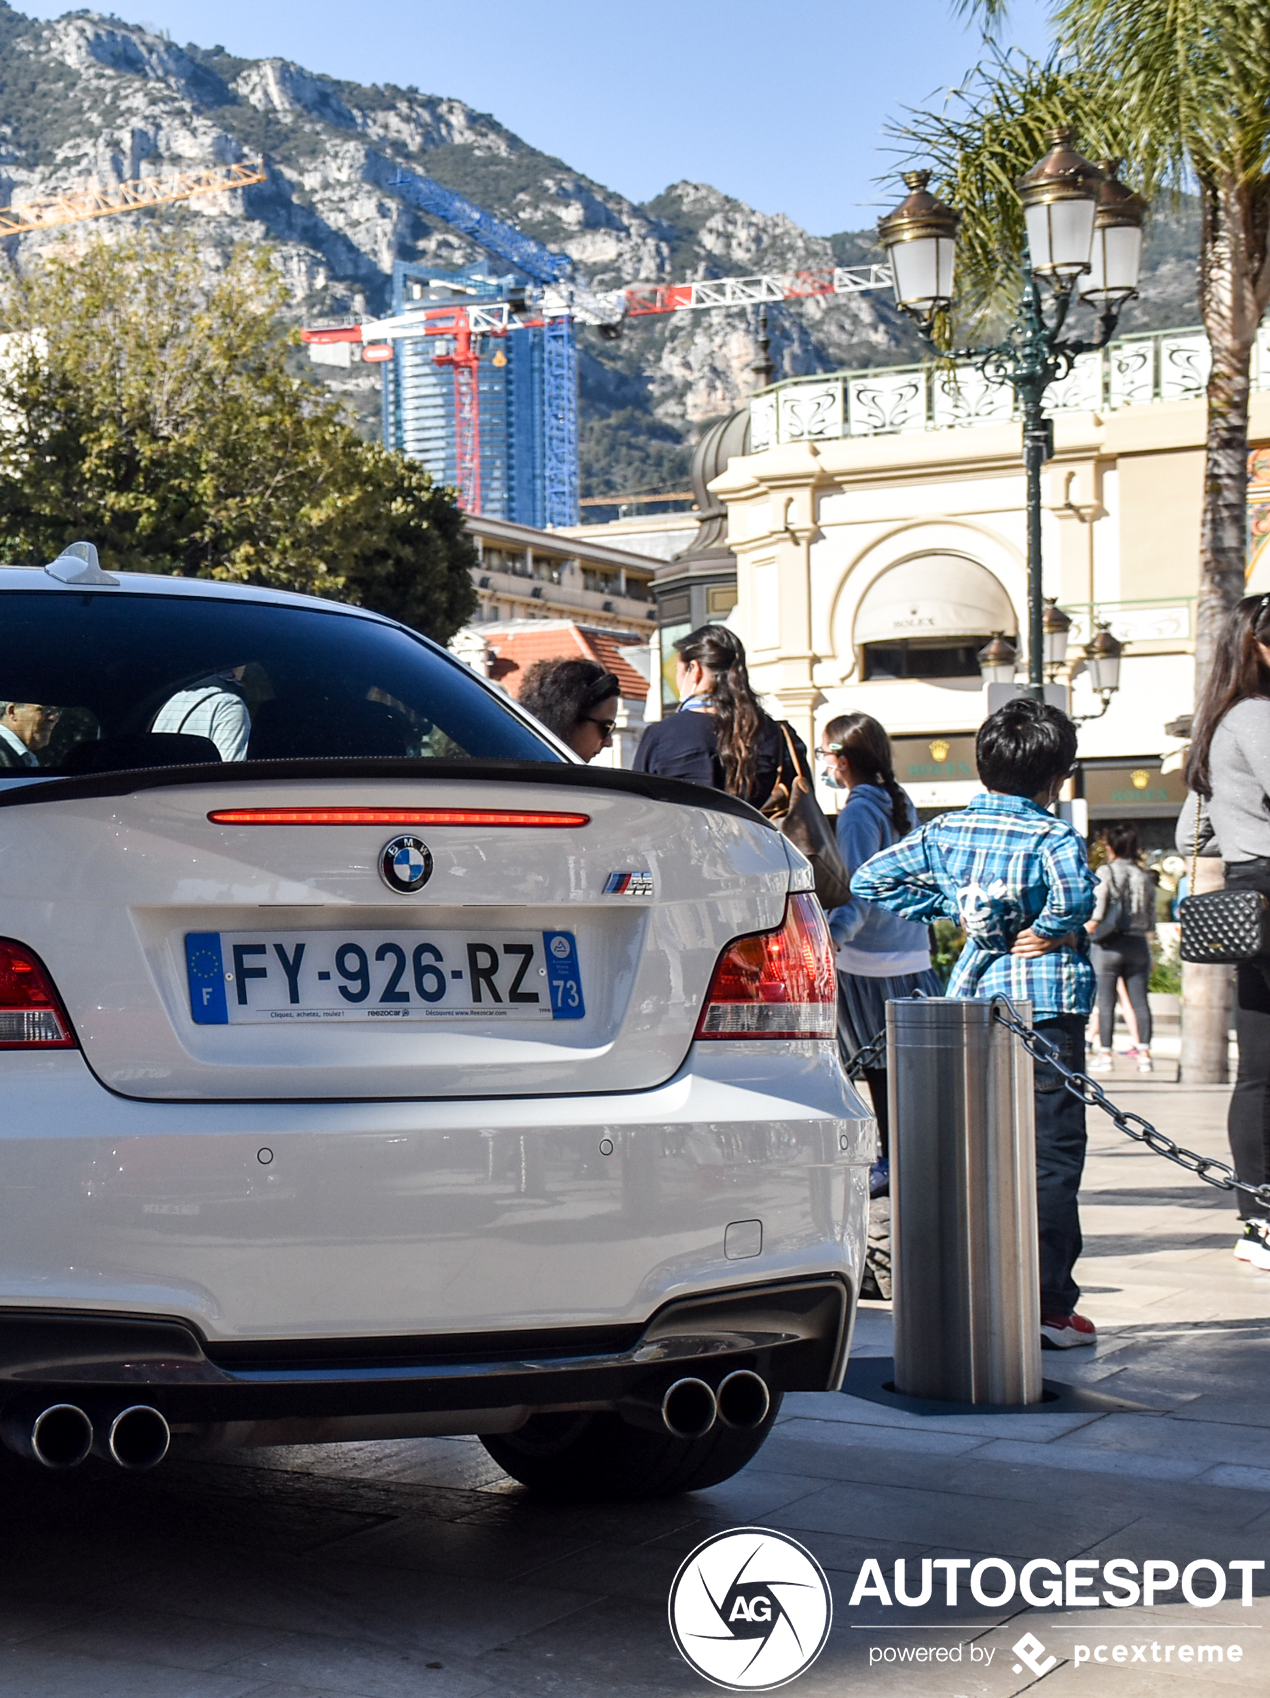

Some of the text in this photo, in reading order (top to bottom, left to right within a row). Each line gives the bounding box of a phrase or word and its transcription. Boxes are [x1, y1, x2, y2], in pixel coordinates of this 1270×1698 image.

[388, 838, 429, 856] BMW
[232, 942, 540, 1005] FY-926-RZ
[202, 988, 213, 1005] F
[552, 980, 579, 1007] 73
[367, 1009, 401, 1017] reezocar
